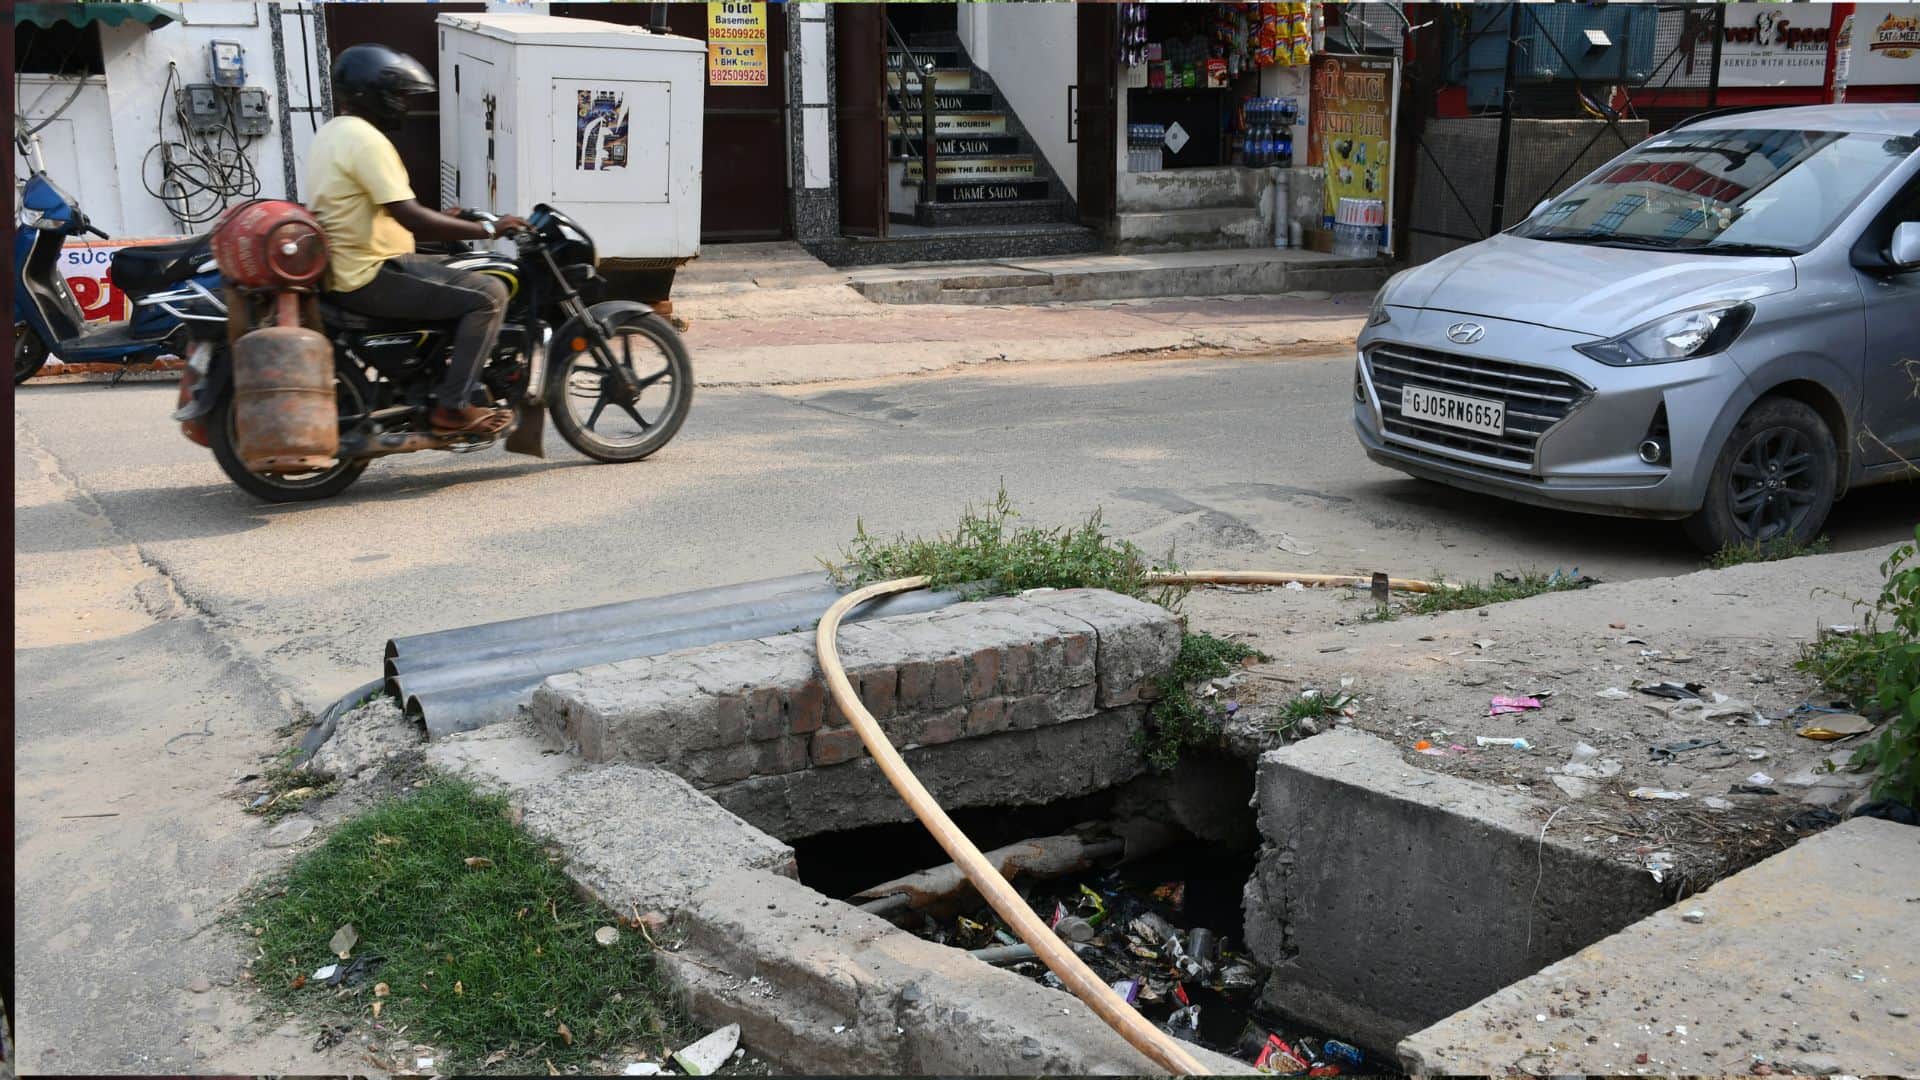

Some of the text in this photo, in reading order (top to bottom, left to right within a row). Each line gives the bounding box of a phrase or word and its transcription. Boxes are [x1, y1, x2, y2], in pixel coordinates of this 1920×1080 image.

[722, 3, 752, 14] To Let
[715, 16, 758, 25] Basement
[709, 28, 765, 39] 9825099226
[1880, 32, 1892, 41] EAT
[719, 47, 754, 56] To Let
[721, 58, 737, 66] BHK
[1724, 59, 1826, 67] SERVED WITH ELEGANC
[711, 70, 765, 81] 9825099226
[959, 141, 989, 153] SALON
[988, 187, 1018, 200] SALON
[1413, 393, 1501, 429] GJ05RN6652
